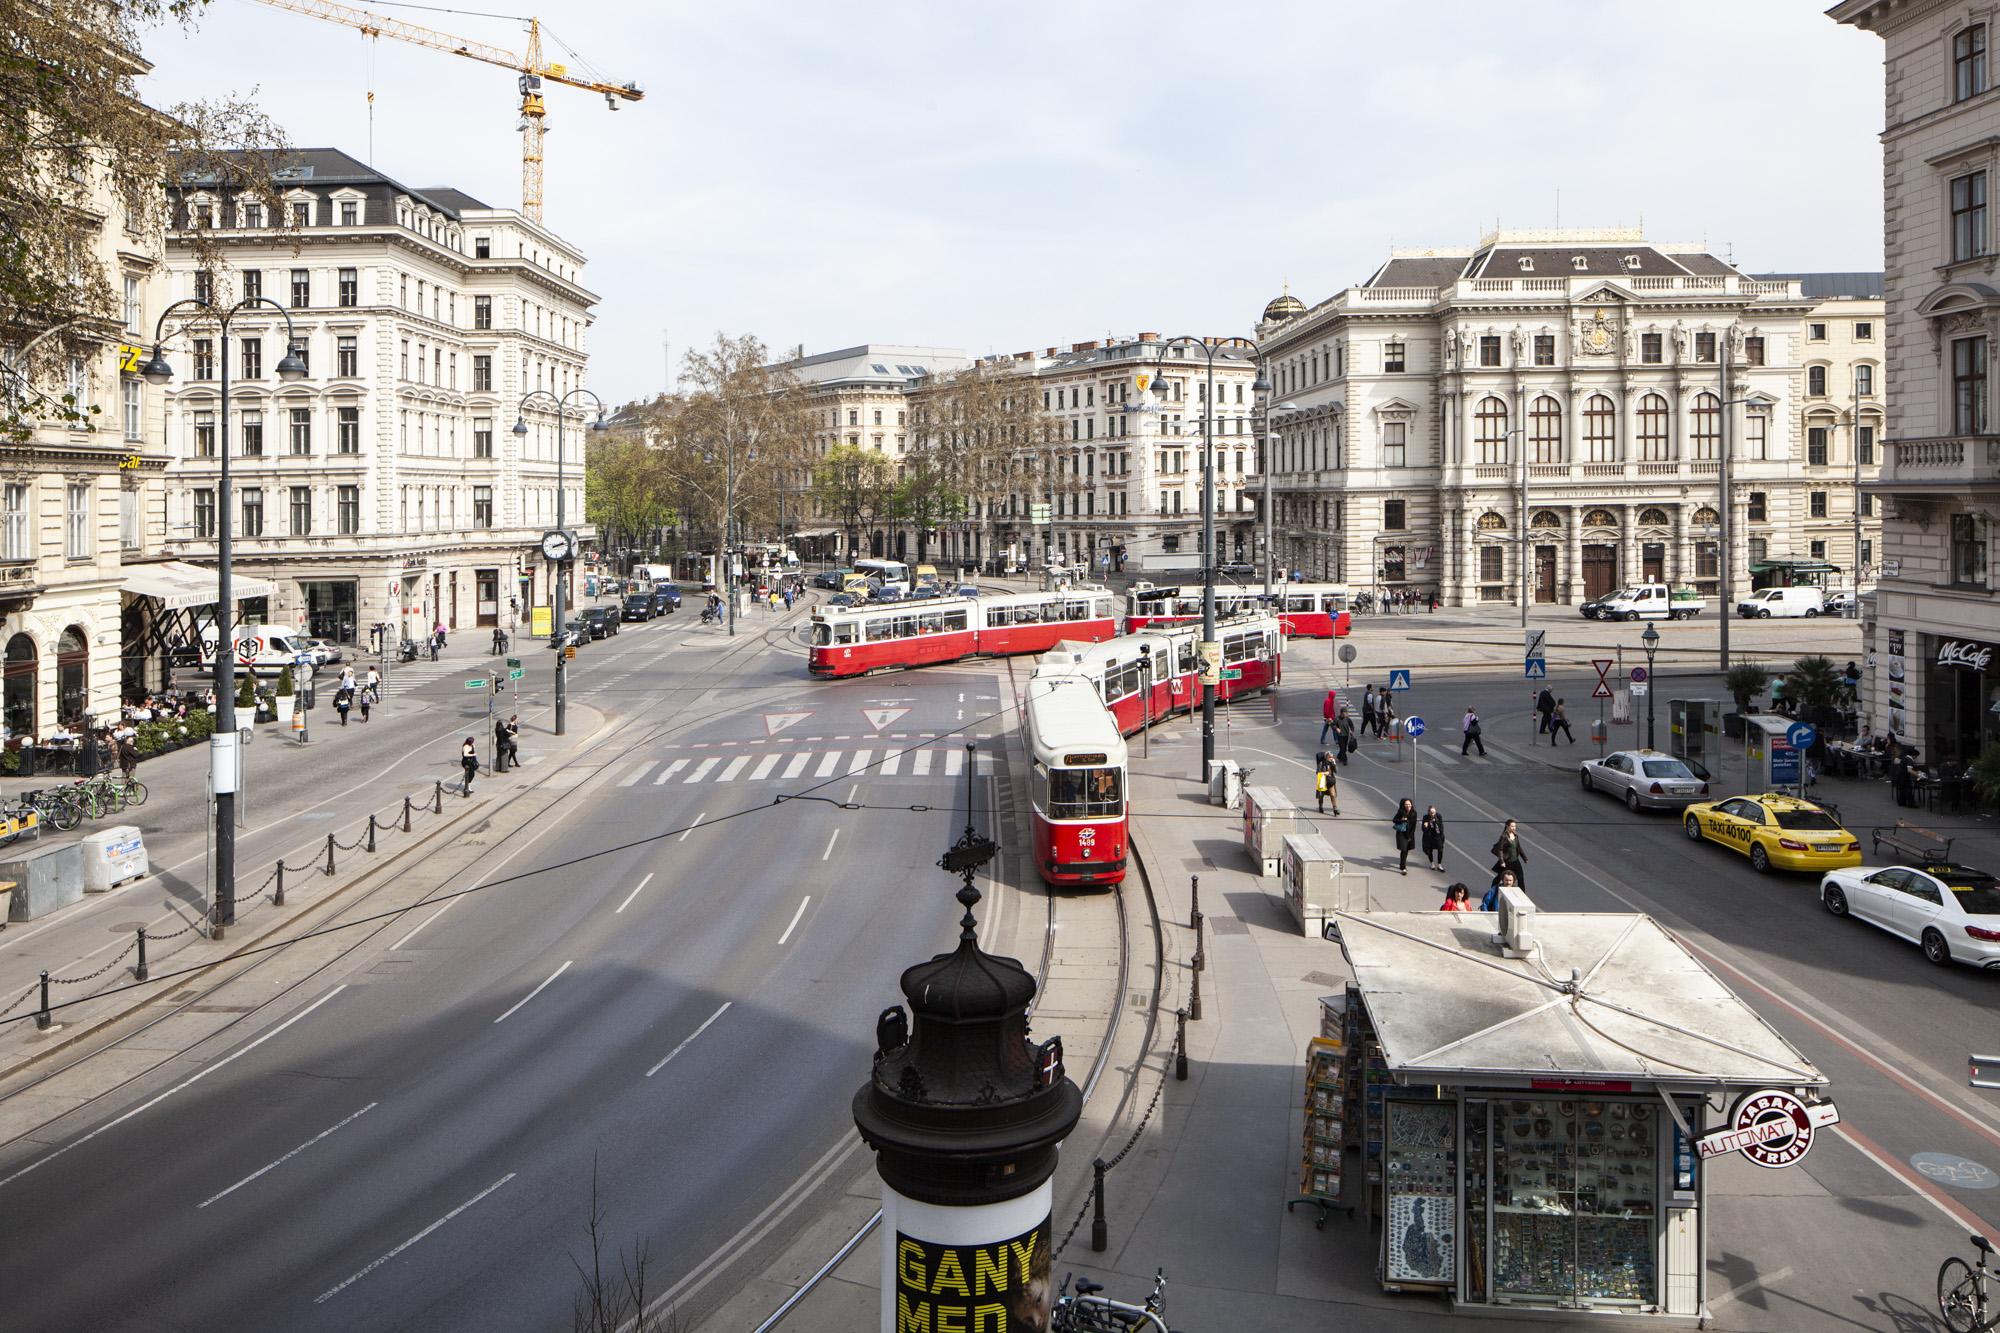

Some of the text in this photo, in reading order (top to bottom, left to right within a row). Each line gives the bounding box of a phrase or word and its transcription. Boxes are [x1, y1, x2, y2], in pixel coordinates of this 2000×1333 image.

[1611, 488, 1655, 496] KASINO
[178, 593, 206, 605] KONZERT
[1938, 641, 1992, 669] McCafé
[1708, 818, 1726, 836] TAXI
[1078, 838, 1095, 847] 1489
[1740, 1097, 1799, 1126] TABAK
[1701, 1120, 1788, 1158] AUTOMAT
[1754, 1127, 1810, 1163] TRAFIK
[899, 1230, 1039, 1297] GANY
[898, 1292, 1007, 1333] MED
